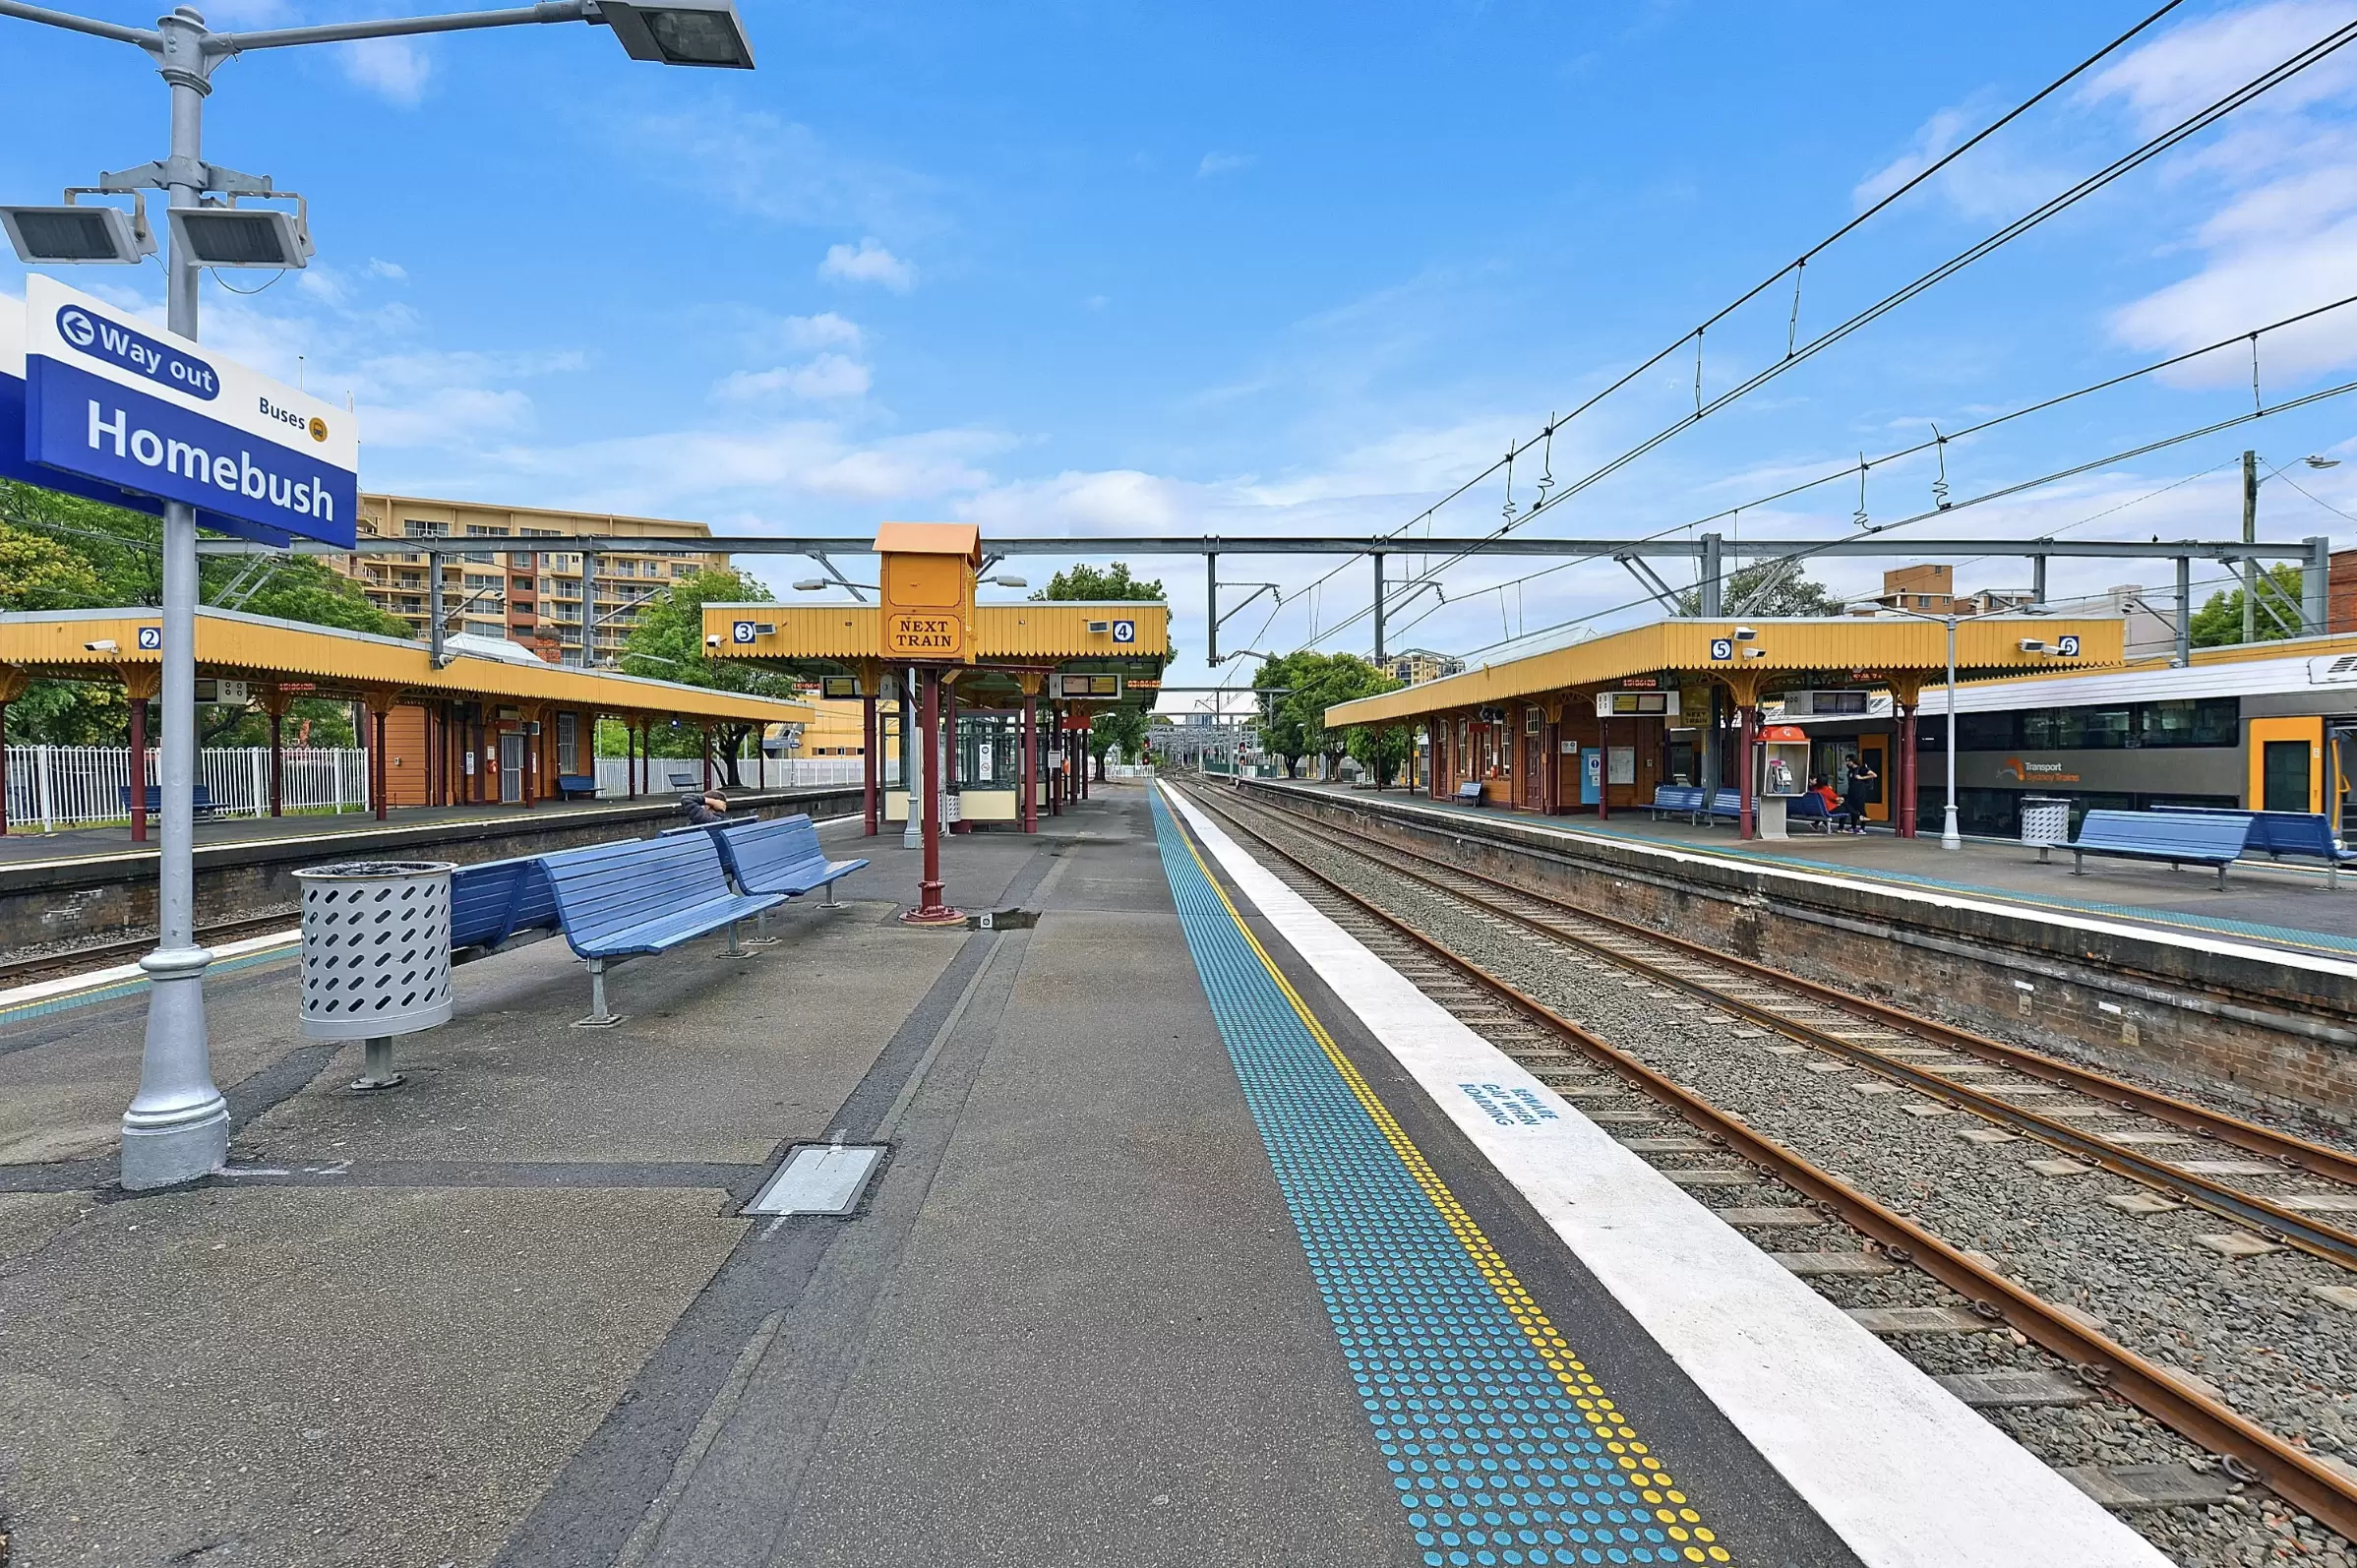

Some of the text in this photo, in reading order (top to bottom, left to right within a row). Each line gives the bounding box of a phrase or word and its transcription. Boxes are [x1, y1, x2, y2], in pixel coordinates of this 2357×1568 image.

[99, 322, 213, 392] Way out
[259, 395, 306, 431] Buses
[88, 398, 334, 522] Homebush
[739, 626, 751, 641] 3
[900, 620, 948, 633] NEXT
[1118, 625, 1128, 638] 4
[145, 631, 155, 646] 2
[896, 634, 952, 647] TRAIN
[1718, 642, 1726, 656] 5
[2025, 761, 2062, 772] Transport
[1457, 1083, 1515, 1127] BOARDING
[1481, 1083, 1541, 1126] GAP WHEN
[1509, 1087, 1558, 1120] BEWARE
